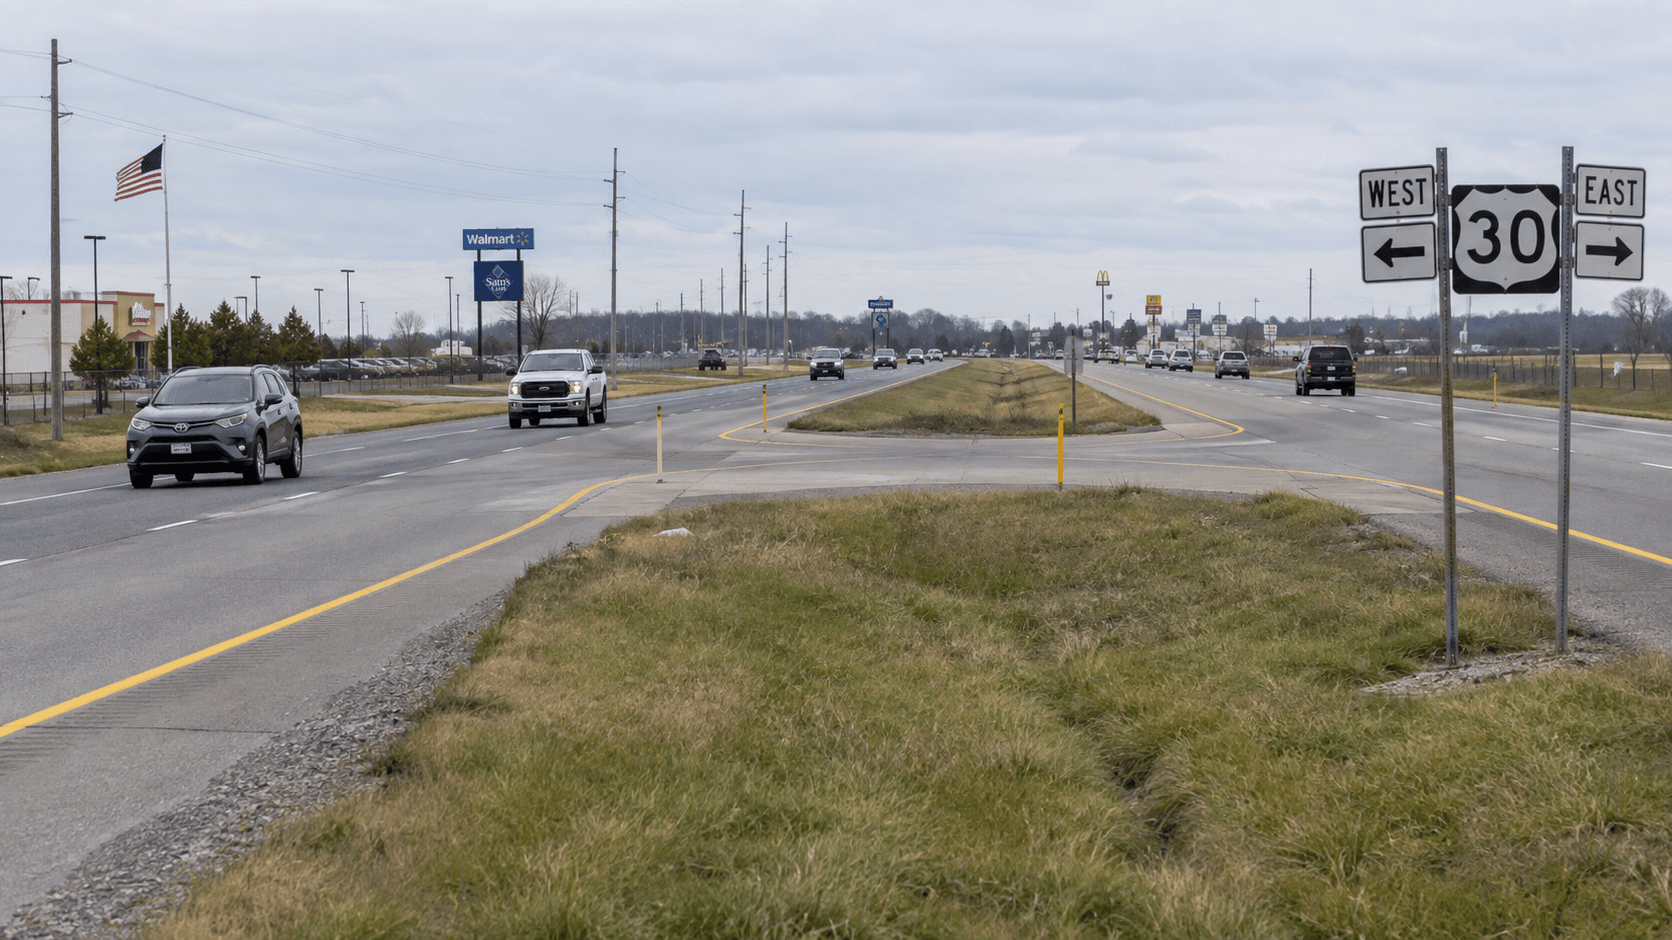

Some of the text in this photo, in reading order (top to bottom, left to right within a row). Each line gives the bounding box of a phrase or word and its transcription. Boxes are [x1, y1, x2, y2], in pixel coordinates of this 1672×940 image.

[1368, 178, 1427, 208] WEST
[1585, 175, 1638, 206] EAST
[467, 234, 515, 244] Walmart
[1467, 209, 1546, 265] 30
[485, 277, 511, 287] Sam's
